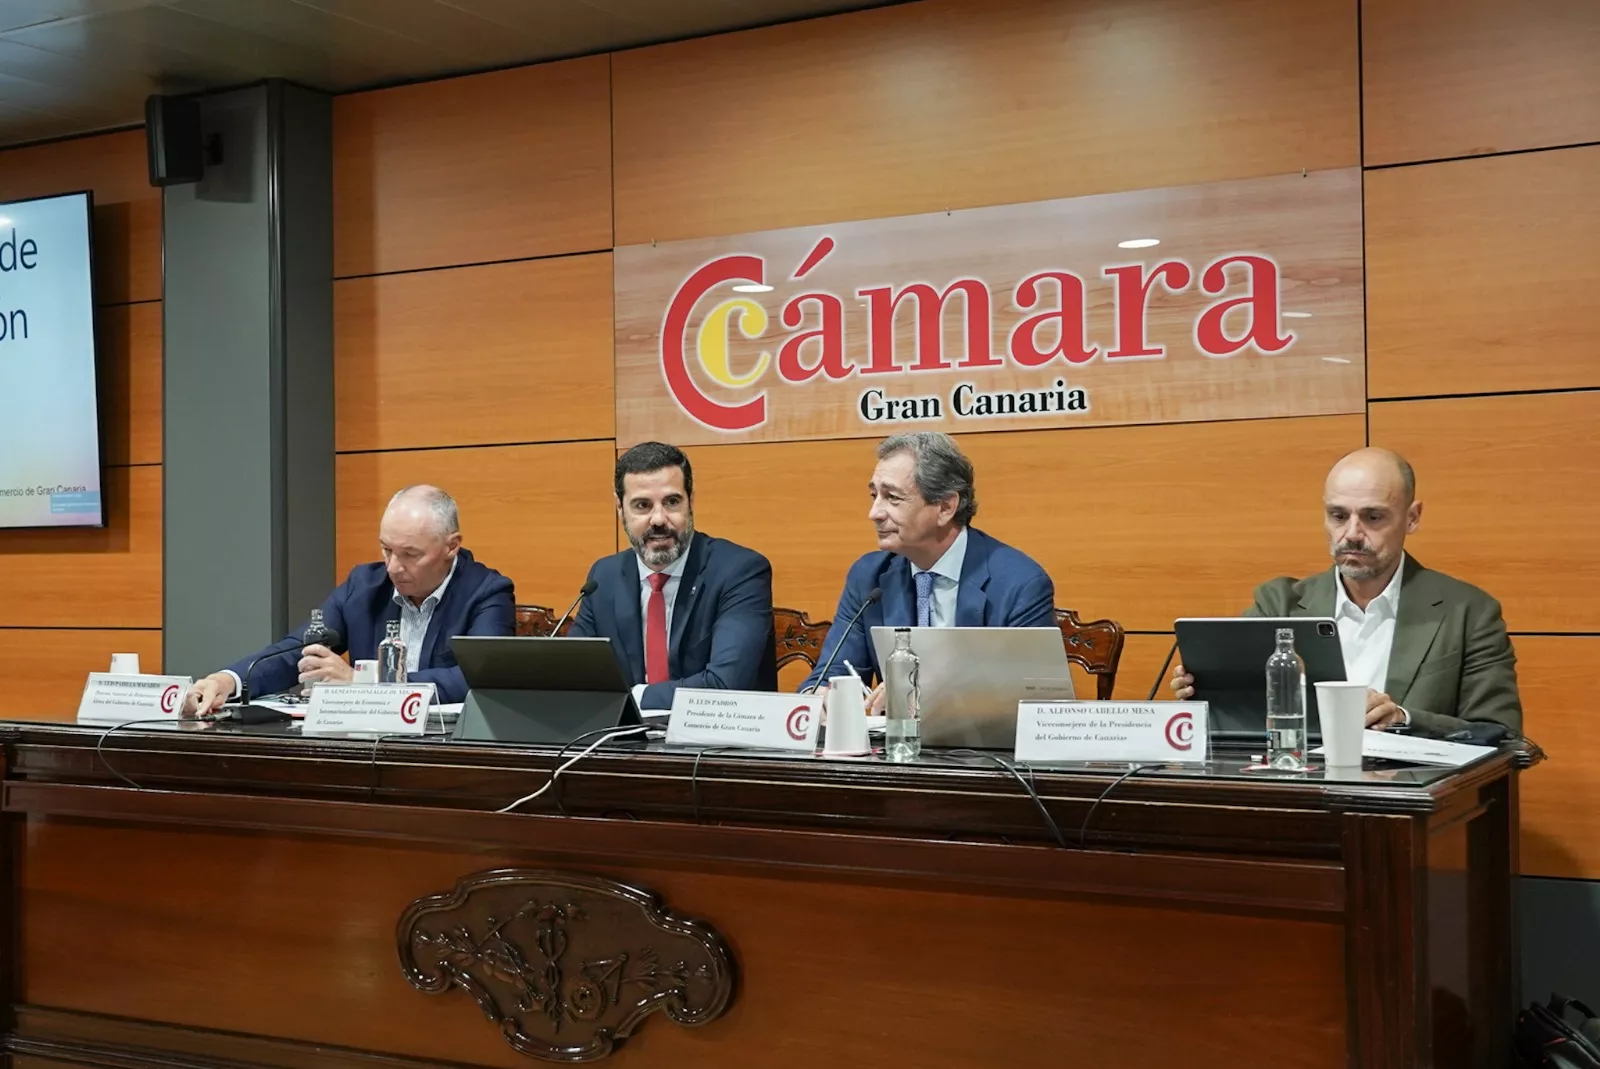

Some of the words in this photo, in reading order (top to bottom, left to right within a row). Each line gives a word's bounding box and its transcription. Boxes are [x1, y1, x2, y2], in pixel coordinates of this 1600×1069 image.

[0, 228, 38, 272] de
[860, 388, 942, 422] Gran
[953, 380, 1087, 416] Canaria
[25, 486, 35, 496] de
[36, 485, 56, 496] Gran
[56, 484, 87, 493] Canaria
[1049, 707, 1087, 715] ALFONSO
[1088, 707, 1129, 715] CABELLO
[1131, 707, 1156, 715] MESA
[721, 723, 736, 731] Gran
[1036, 720, 1086, 730] Viceconsejero
[1089, 720, 1098, 728] de
[1099, 720, 1107, 728] la
[1109, 720, 1152, 729] Presidencia
[1035, 733, 1046, 741] del
[1048, 733, 1082, 741] Gobierno
[1084, 733, 1093, 741] de
[1094, 733, 1128, 741] Canarias
